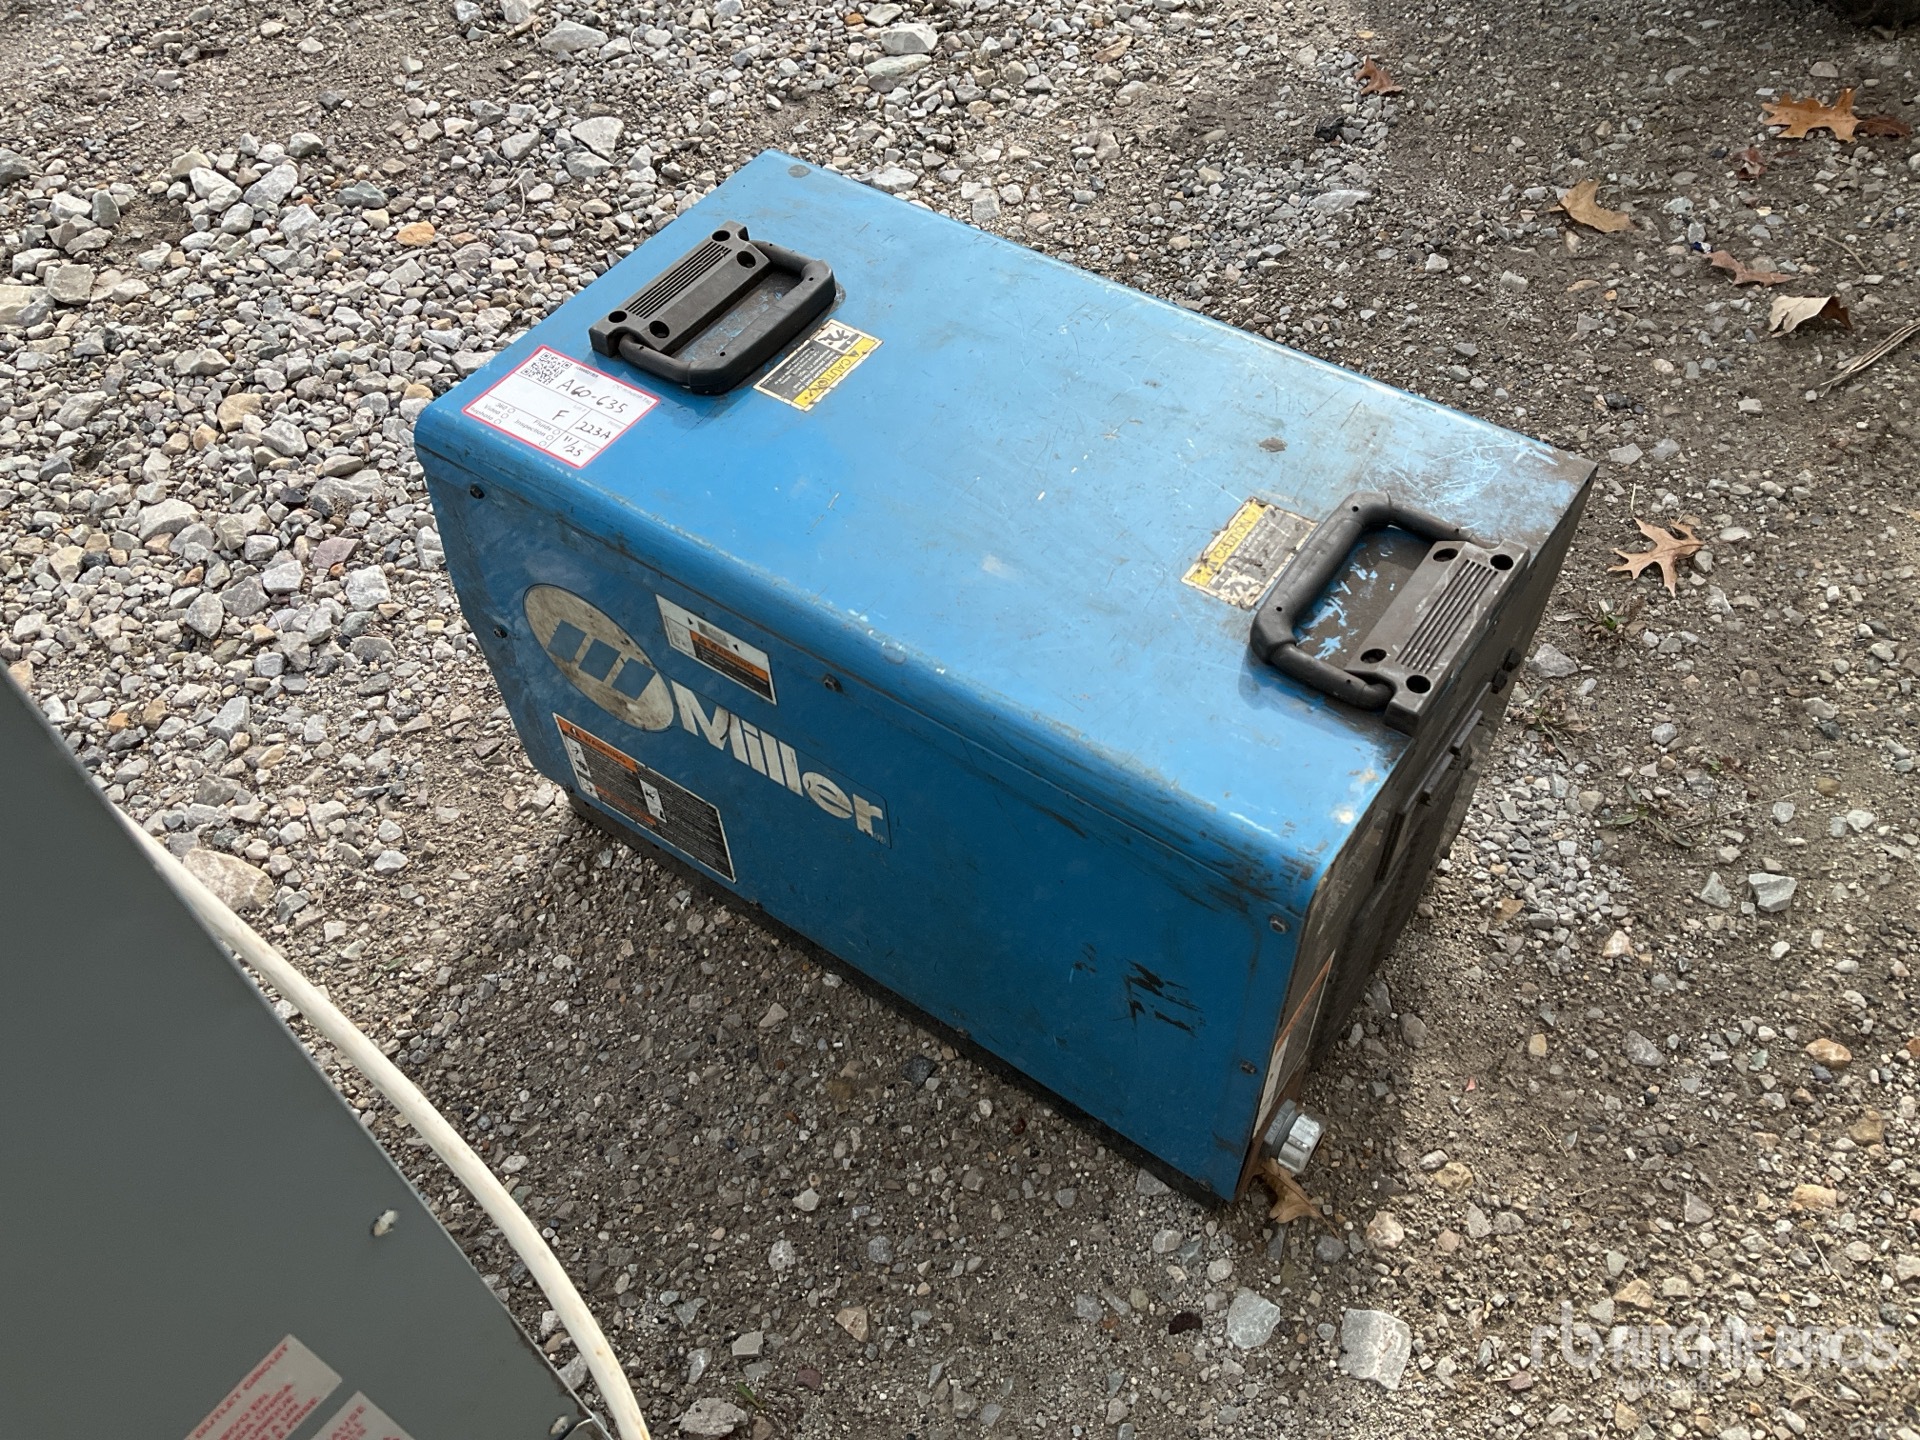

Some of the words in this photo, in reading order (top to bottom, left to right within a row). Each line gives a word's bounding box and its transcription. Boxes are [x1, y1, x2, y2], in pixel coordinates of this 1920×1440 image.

[809, 357, 853, 392] CAUTION
[513, 419, 547, 437] Inspection
[551, 409, 570, 421] F
[574, 420, 611, 440] 223A
[1212, 518, 1253, 559] CAUTION
[670, 680, 883, 837] Miller
